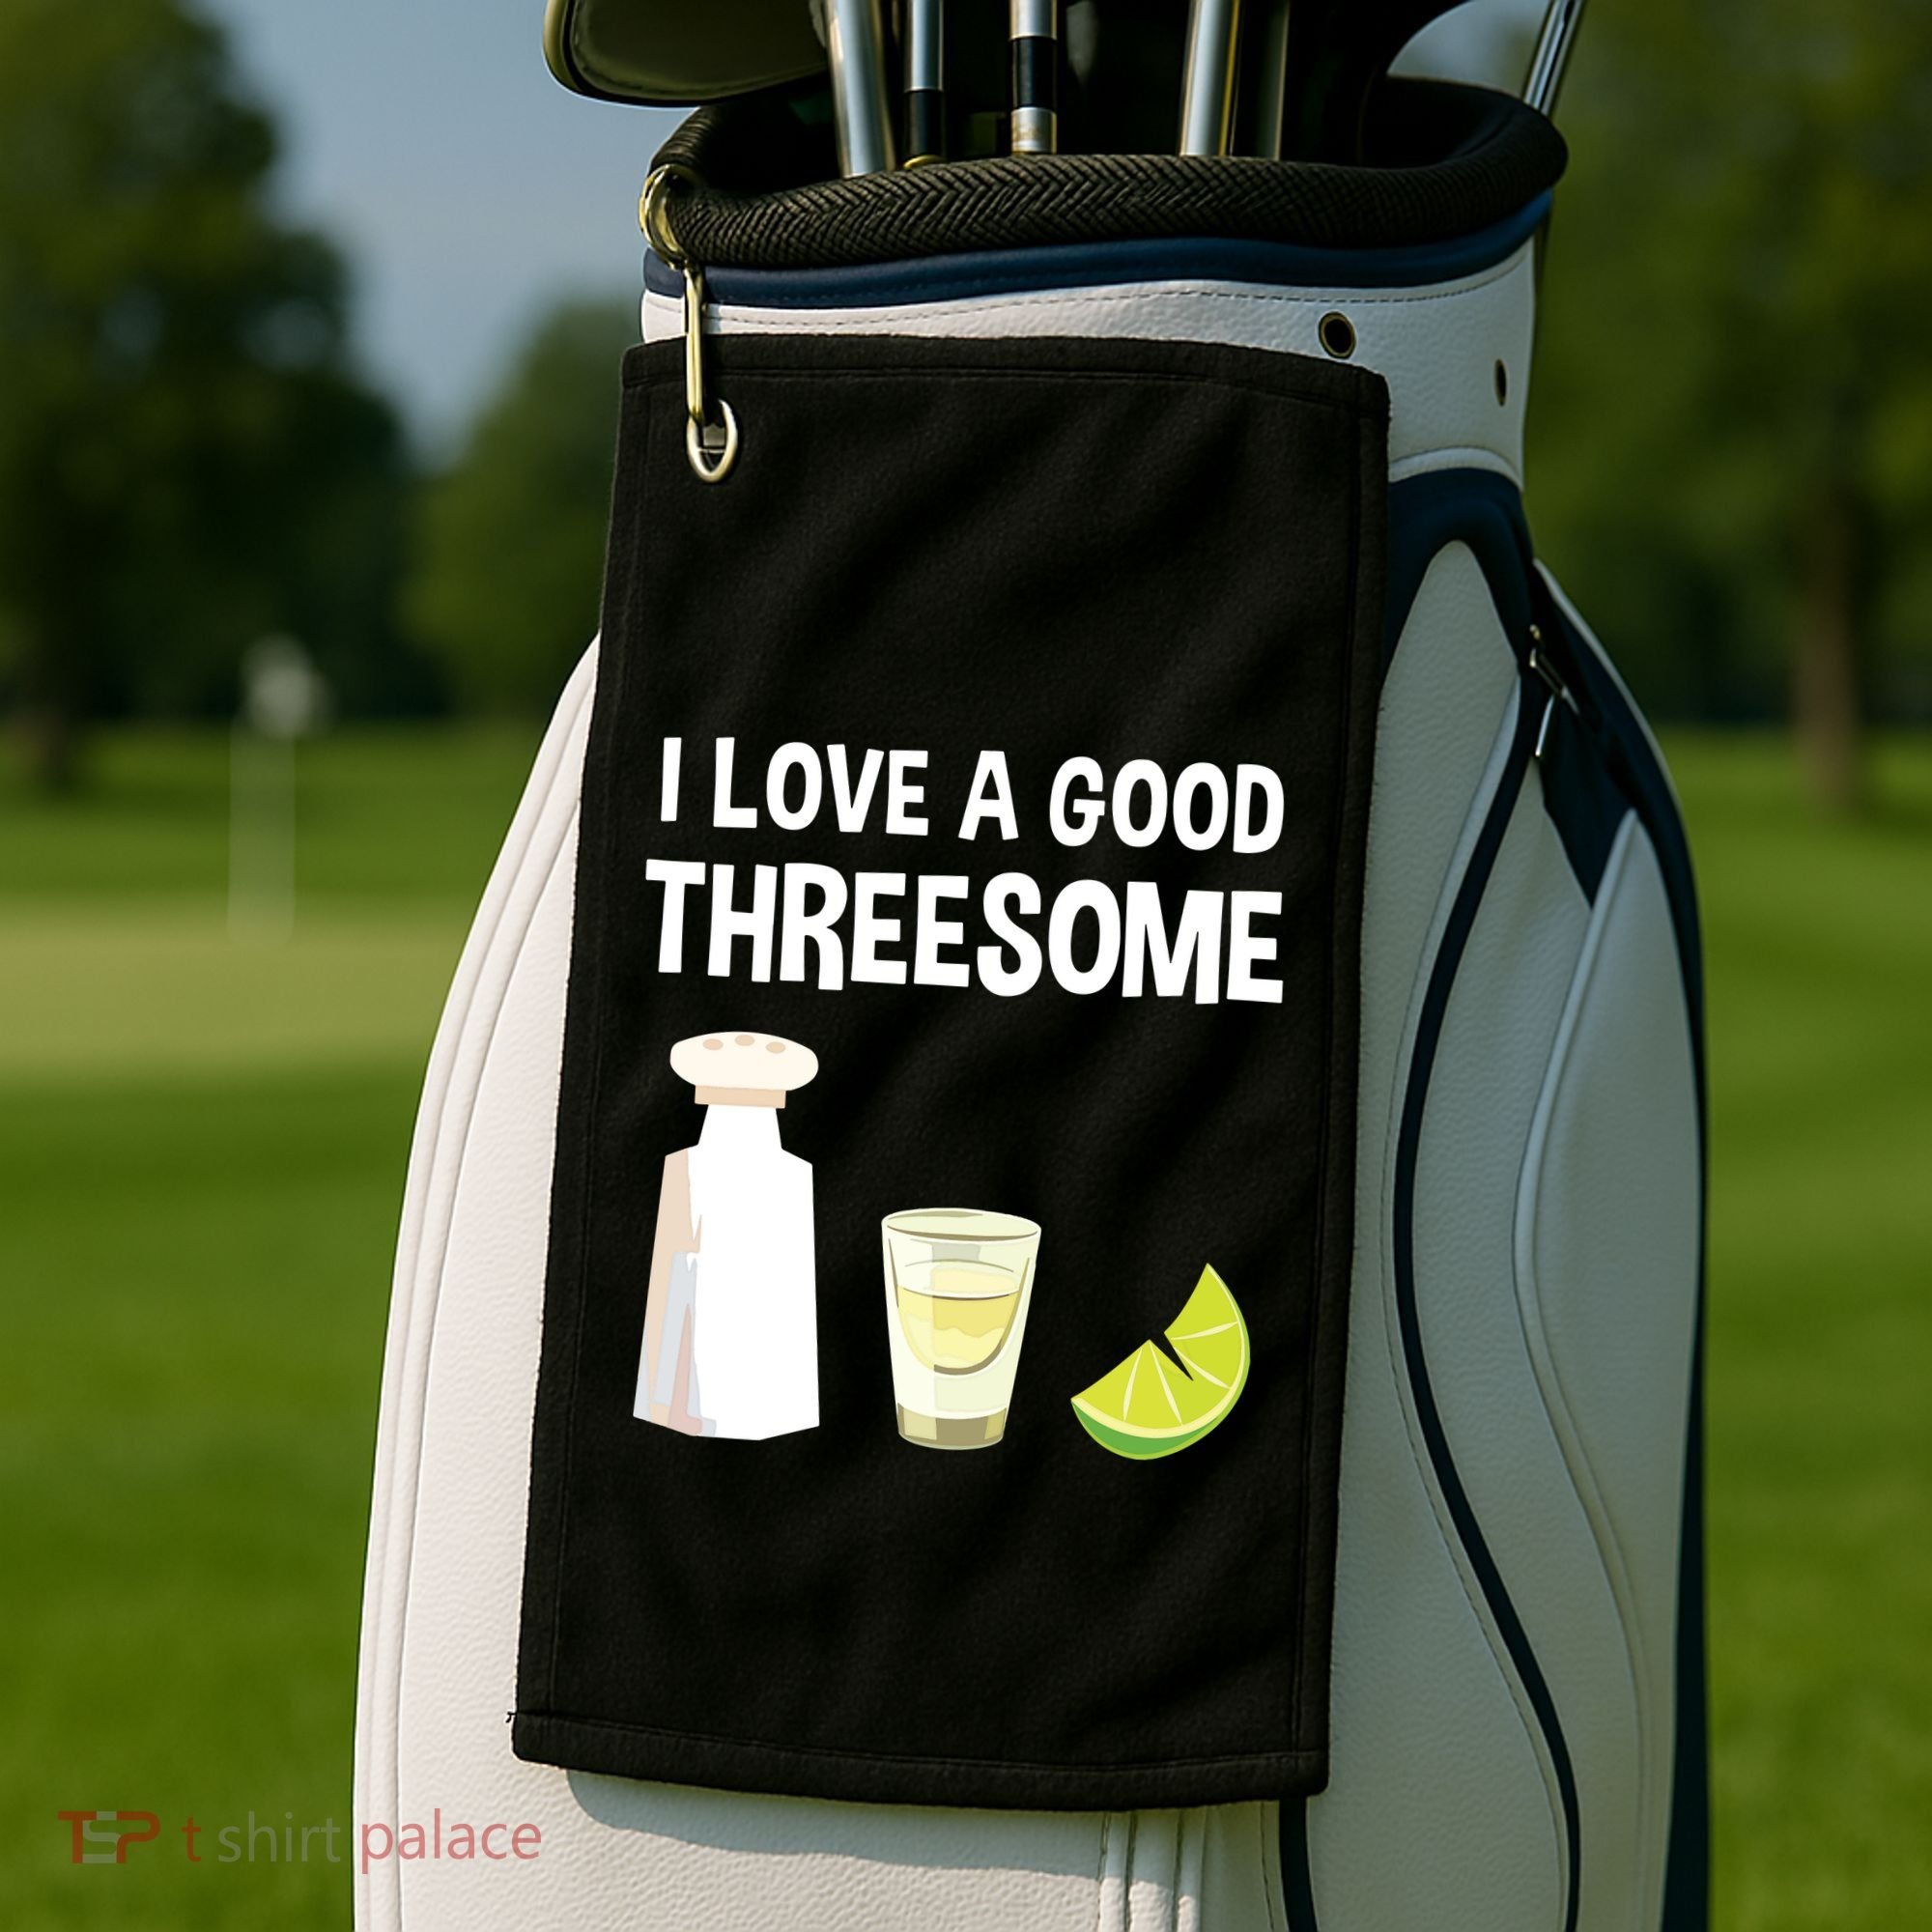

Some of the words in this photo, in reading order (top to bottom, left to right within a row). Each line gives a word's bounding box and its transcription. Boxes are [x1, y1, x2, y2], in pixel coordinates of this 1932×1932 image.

[660, 736, 682, 823] I
[713, 735, 929, 837] LOVE
[957, 750, 1019, 840] A
[1049, 755, 1285, 854] GOOD
[645, 859, 1284, 1005] THREESOME
